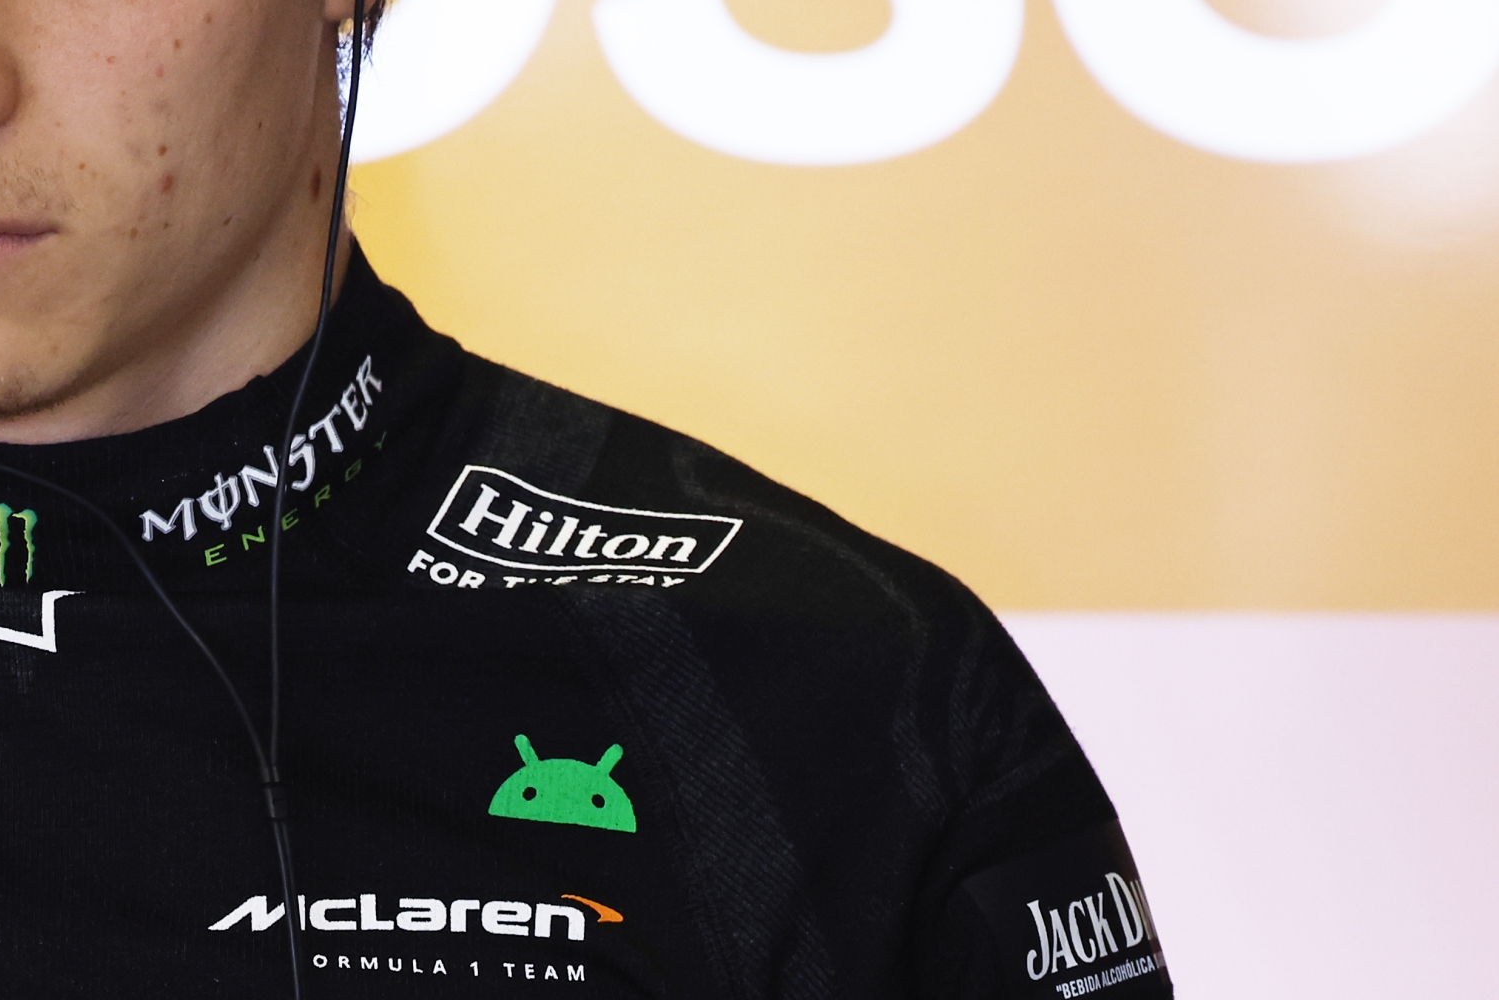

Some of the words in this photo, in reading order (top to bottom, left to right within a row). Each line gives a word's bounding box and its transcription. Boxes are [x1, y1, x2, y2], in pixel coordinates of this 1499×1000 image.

[204, 431, 387, 567] ENERGY
[458, 483, 698, 563] Hilton
[407, 549, 486, 589] FOR
[208, 893, 586, 941] McLaren
[1026, 892, 1119, 981] JACK
[312, 954, 447, 975] ORMULA
[469, 961, 480, 977] 1
[503, 962, 585, 982] TEAM
